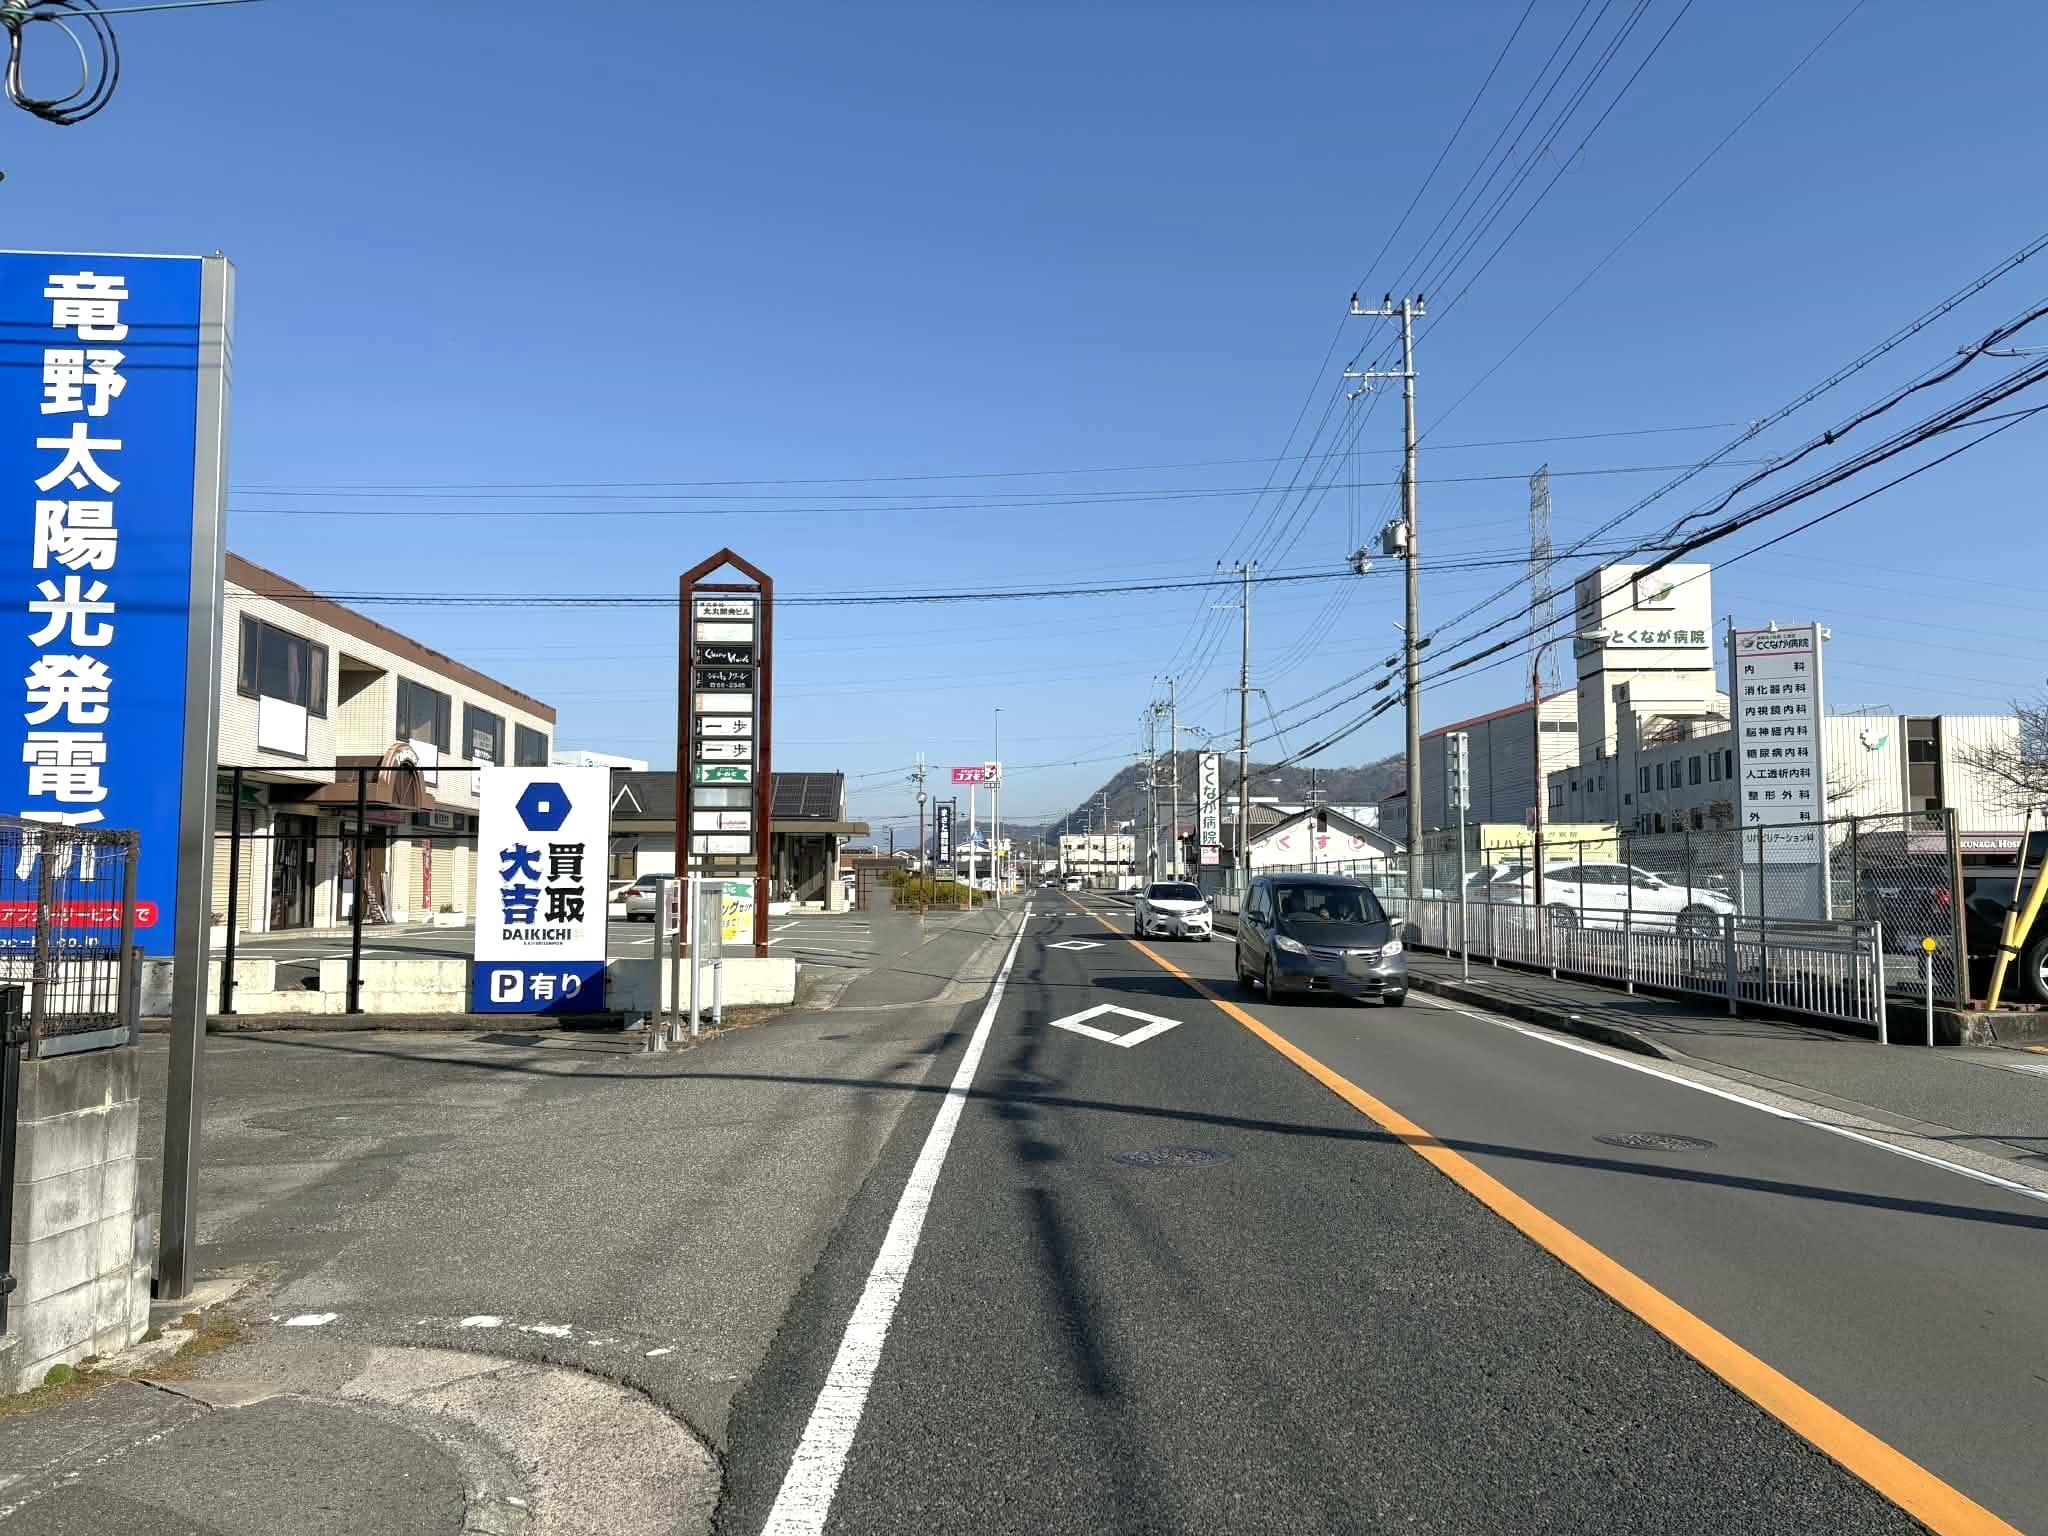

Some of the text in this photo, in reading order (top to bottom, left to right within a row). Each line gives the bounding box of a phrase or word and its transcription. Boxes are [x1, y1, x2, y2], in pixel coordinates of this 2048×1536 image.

[1611, 629, 1706, 644] とくなが病院
[1756, 638, 1809, 650] とくなが病院
[1744, 662, 1805, 674] 内科
[1744, 683, 1806, 696] 消化器内科
[1745, 704, 1807, 716] 内視鏡内科
[705, 720, 748, 733] 一歩
[1746, 726, 1808, 737] 脳神経内科
[705, 744, 748, 757] 一歩
[1746, 747, 1809, 759] 糖尿病内科
[1746, 768, 1811, 779] 人工透析内科
[1202, 754, 1217, 845] とくなが病院
[1748, 789, 1810, 800] 整形外科
[1749, 811, 1810, 822] 外科
[1277, 834, 1367, 849] くすり
[499, 842, 542, 925] 大吉
[544, 842, 586, 924] 買取
[502, 928, 572, 941] DAIKICHI
[498, 972, 582, 1001] P 有り
